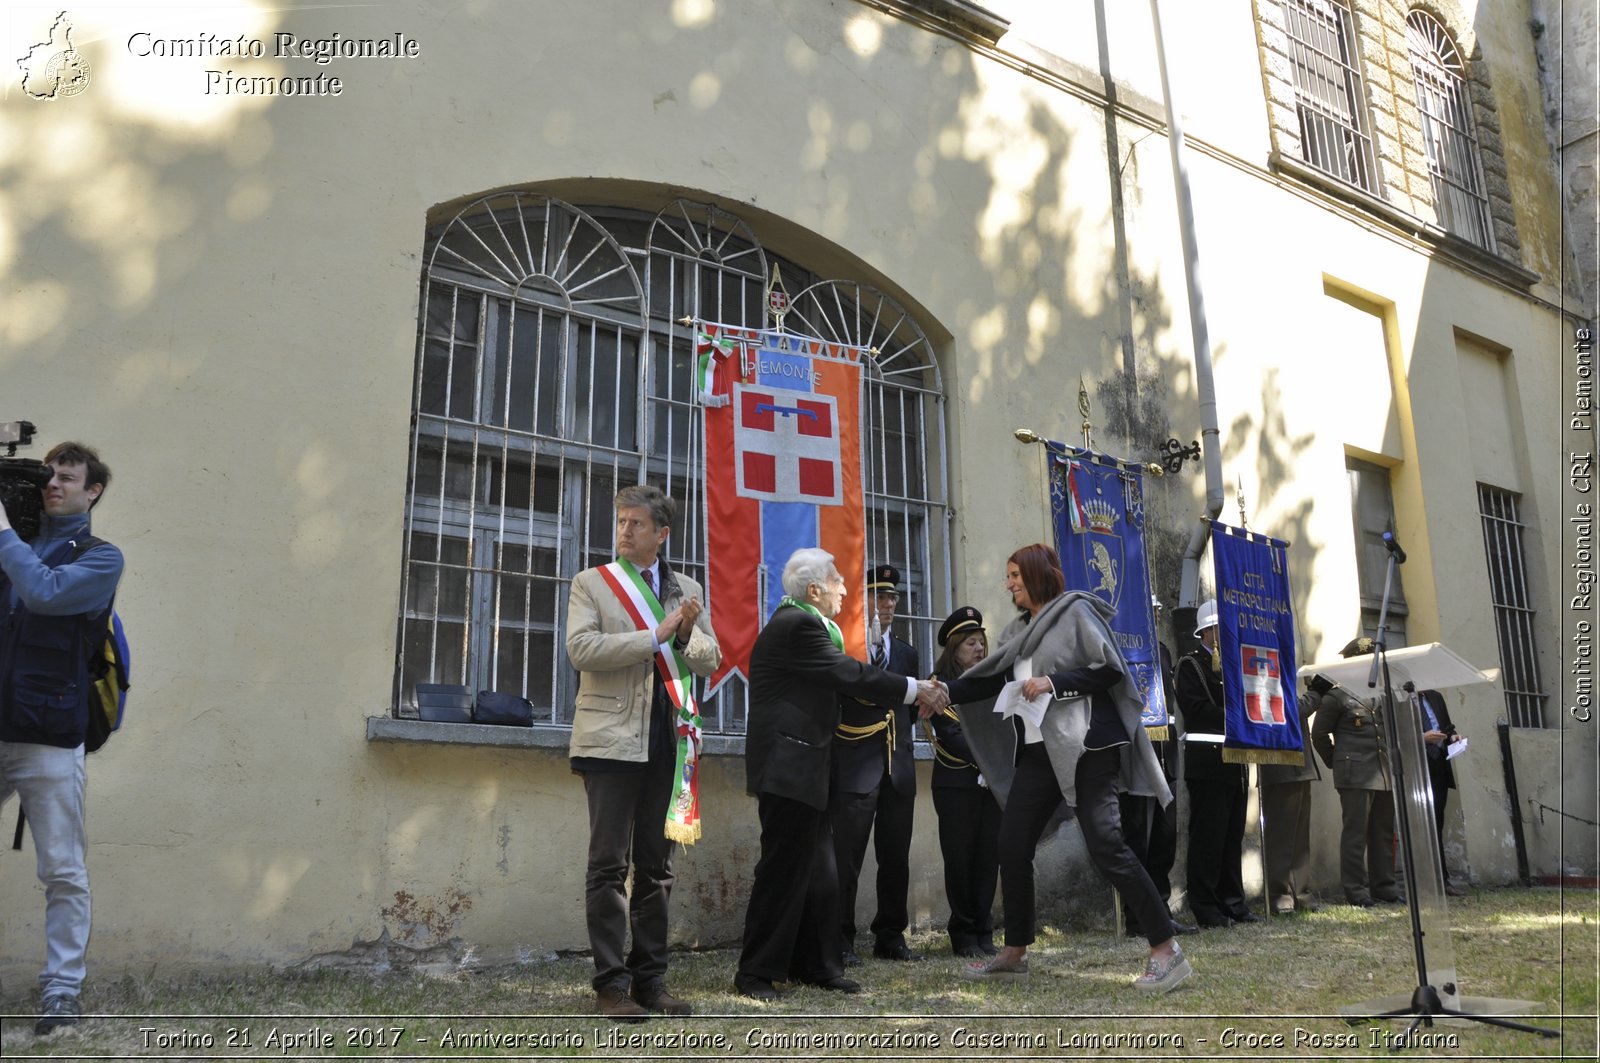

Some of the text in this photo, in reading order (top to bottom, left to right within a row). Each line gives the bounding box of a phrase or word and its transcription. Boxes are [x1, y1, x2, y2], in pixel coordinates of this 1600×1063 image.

[746, 360, 823, 386] PIEMONTE
[1223, 586, 1290, 615] METROPOLITANA
[1238, 612, 1277, 634] DI TORINO
